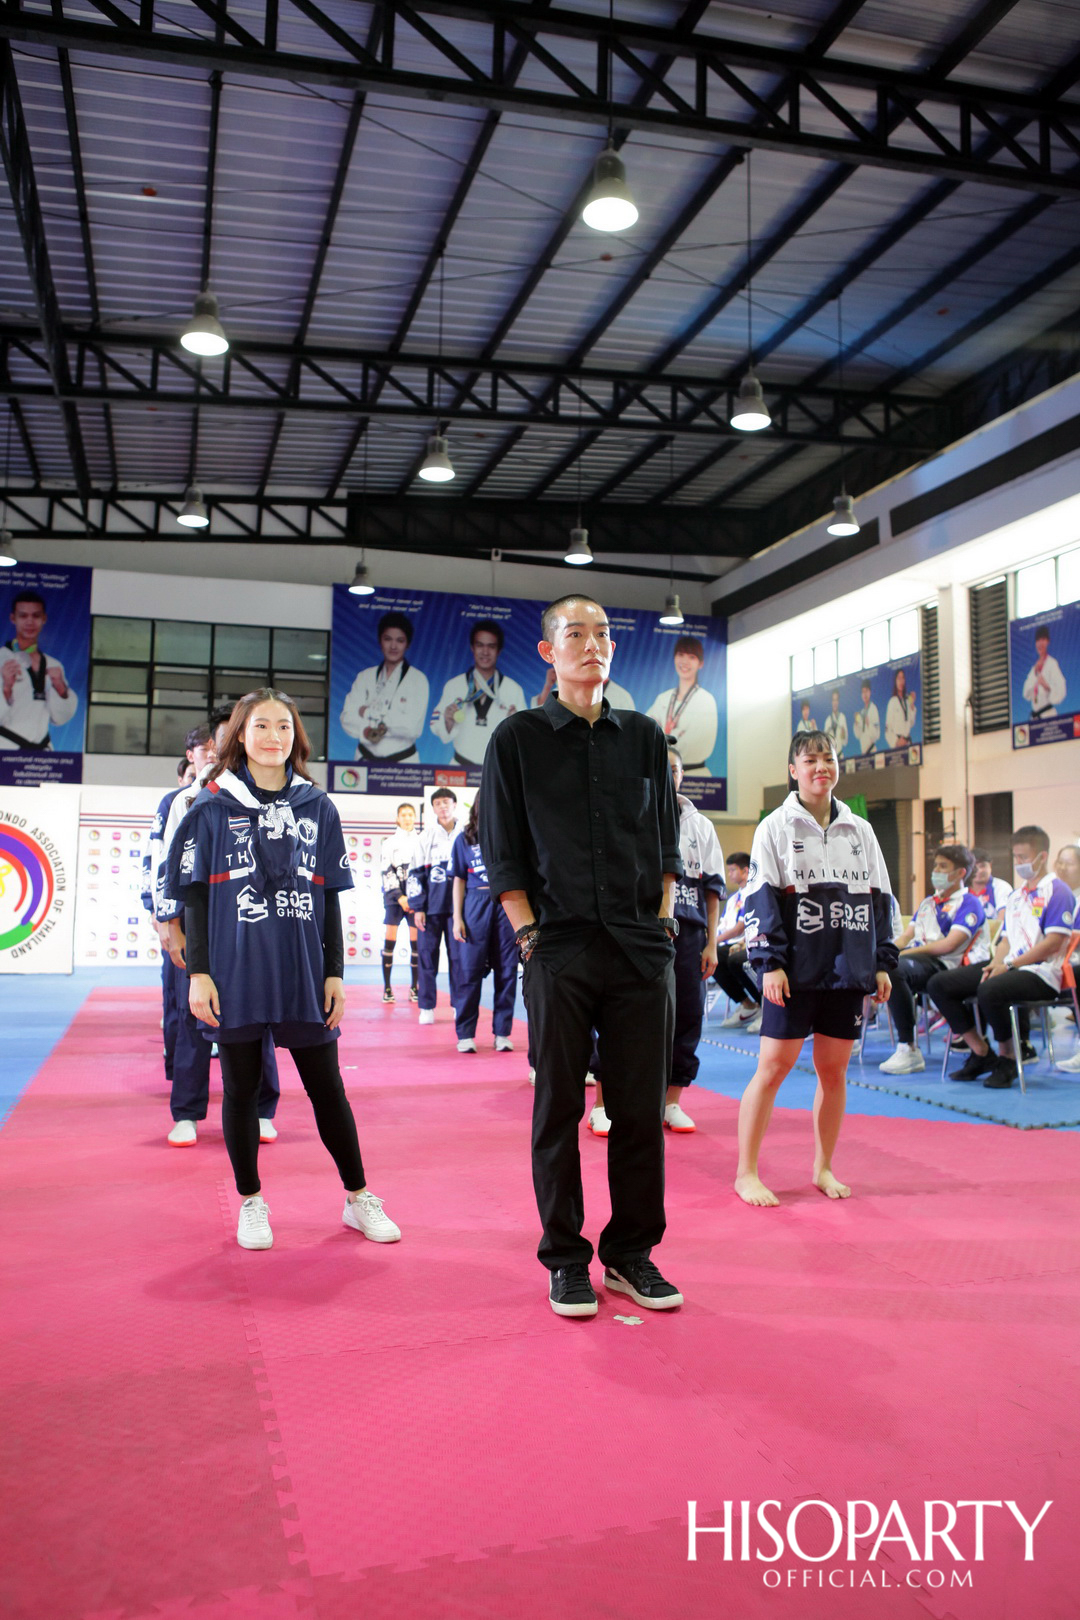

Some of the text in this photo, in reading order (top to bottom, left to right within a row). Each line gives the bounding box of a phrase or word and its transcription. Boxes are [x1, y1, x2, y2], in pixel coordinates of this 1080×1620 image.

[30, 827, 66, 892] ASSOCIATION
[53, 899, 64, 914] OF
[11, 919, 56, 959] THAILAND
